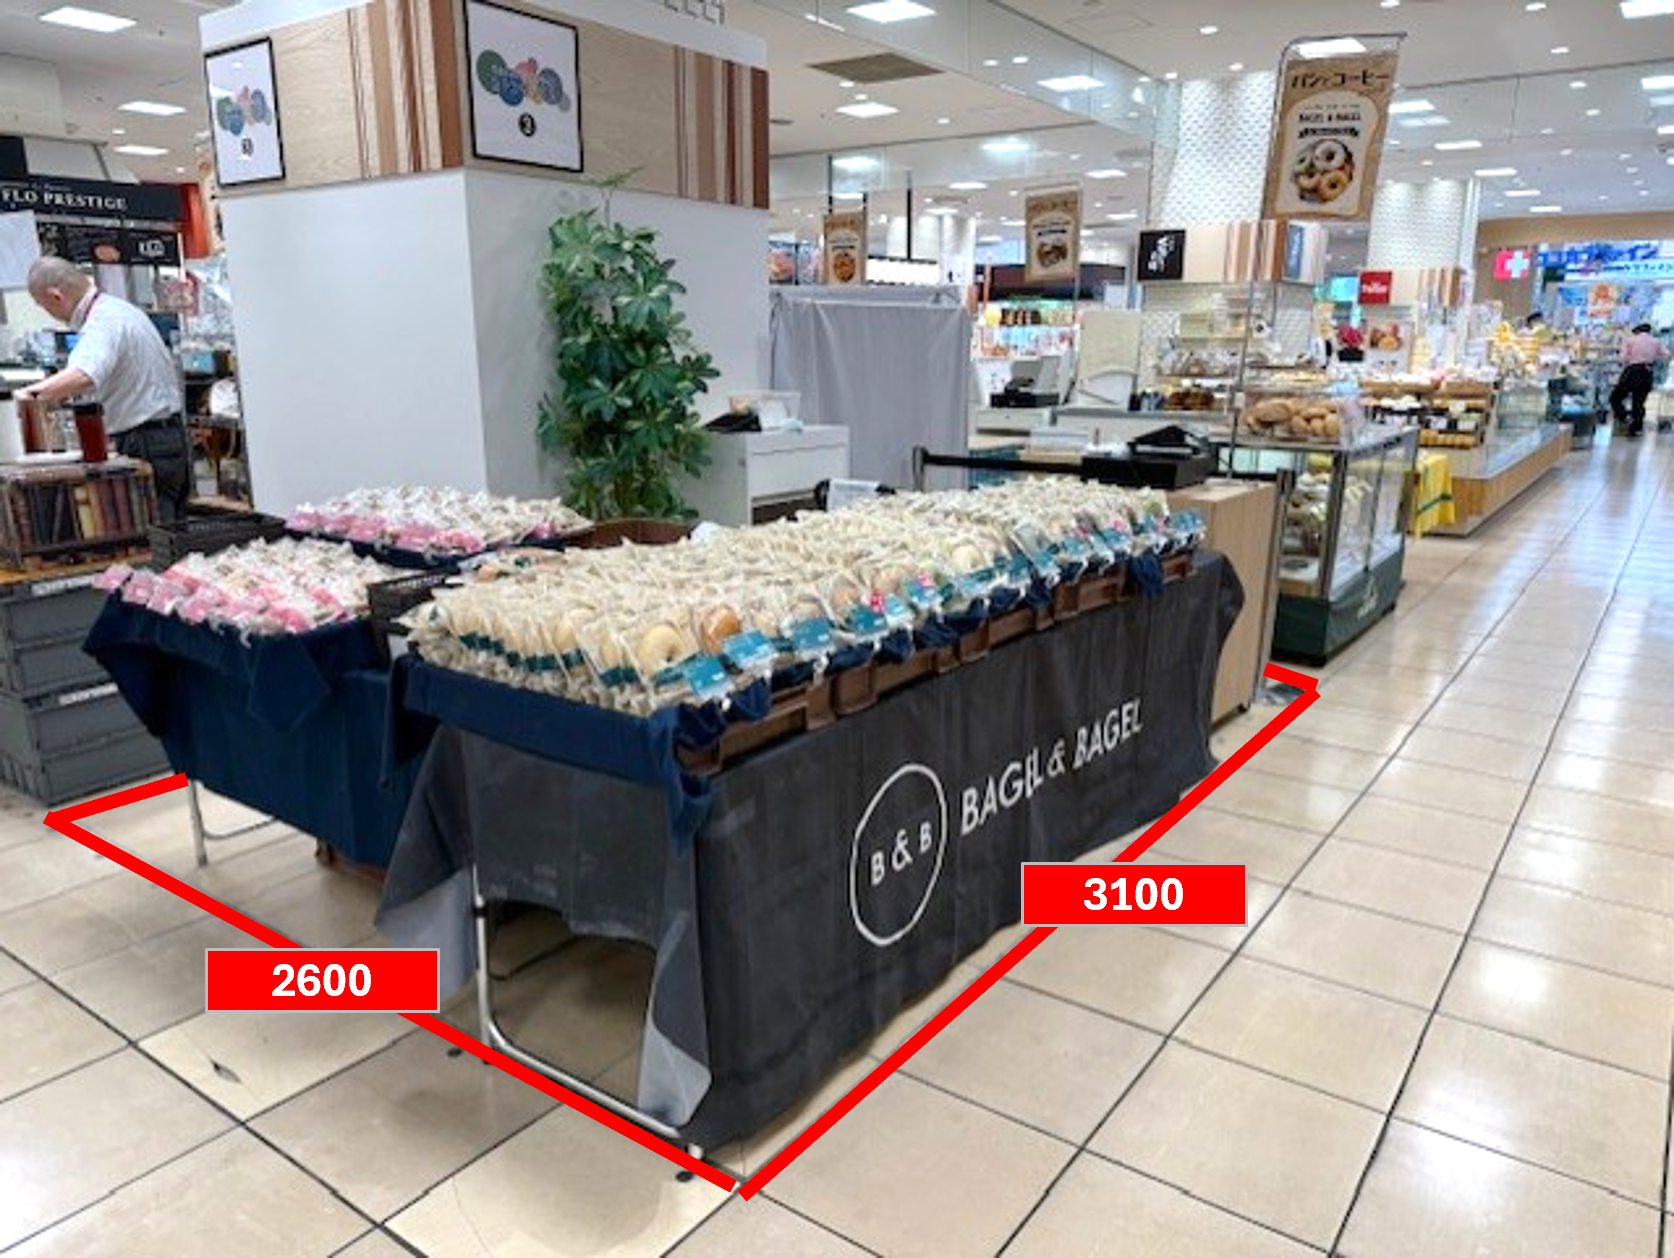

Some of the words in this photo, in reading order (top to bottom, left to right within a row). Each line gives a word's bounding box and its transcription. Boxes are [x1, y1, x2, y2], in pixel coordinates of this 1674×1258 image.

[2, 188, 39, 204] FLO
[43, 192, 128, 212] PRESTIGE
[1047, 739, 1066, 778] &
[1072, 697, 1144, 770] BAGEL
[870, 849, 885, 887] B
[891, 828, 913, 872] &
[919, 820, 932, 853] B
